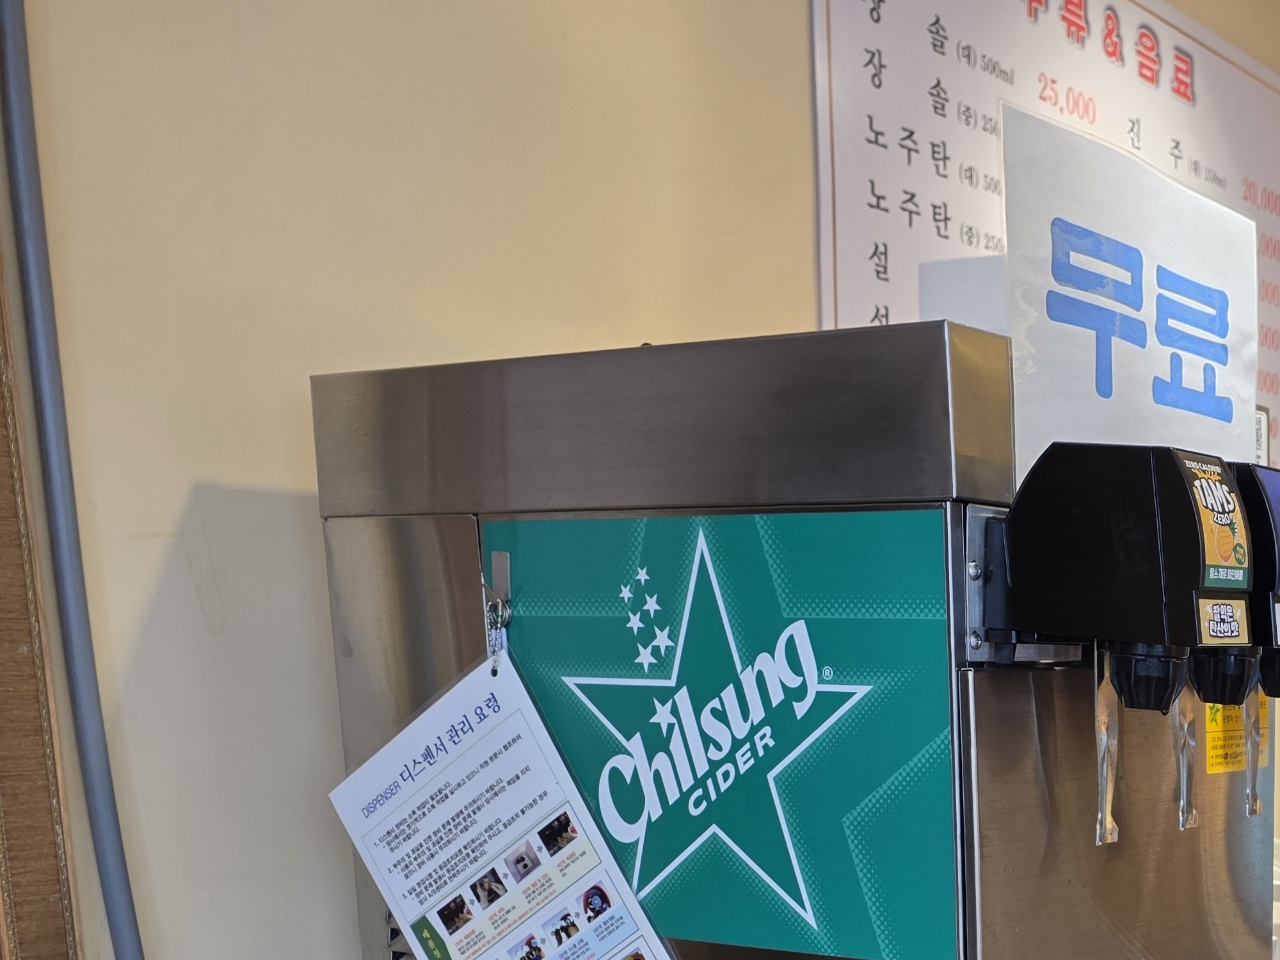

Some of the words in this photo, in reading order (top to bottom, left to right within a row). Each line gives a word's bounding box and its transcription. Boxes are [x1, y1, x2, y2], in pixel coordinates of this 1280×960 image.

[863, 48, 886, 89] 장
[927, 77, 949, 118] 솔
[926, 14, 949, 56] 솔
[1127, 118, 1141, 151] 진
[1169, 138, 1183, 170] 주
[869, 241, 889, 282] 설
[1047, 217, 1235, 424] 무료
[1194, 479, 1234, 512] TAMS
[1214, 512, 1230, 525] ZERO
[361, 780, 401, 818] DISPENSER
[398, 735, 448, 782] 디스펜서
[445, 713, 474, 745] 관리
[473, 691, 500, 724] 요령
[598, 619, 818, 843] Chilsung
[688, 725, 776, 816] CIDER
